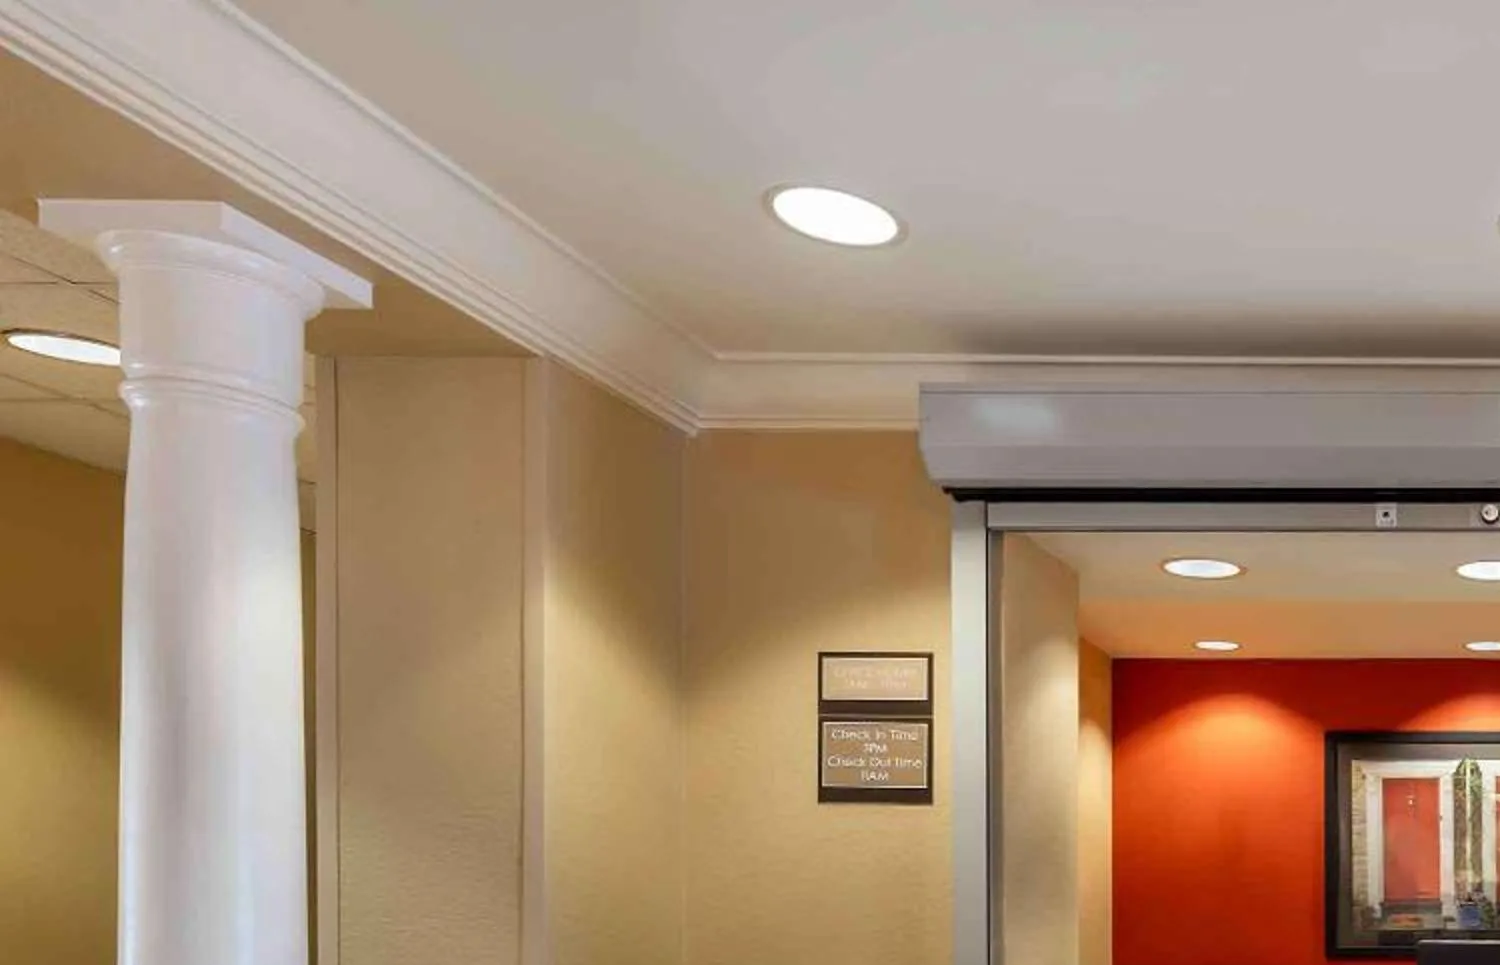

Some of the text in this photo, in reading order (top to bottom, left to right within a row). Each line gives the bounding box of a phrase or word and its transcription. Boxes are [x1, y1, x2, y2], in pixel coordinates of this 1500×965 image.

[831, 729, 871, 741] Check
[889, 729, 918, 742] Time
[827, 756, 866, 769] Check
[869, 756, 891, 769] Out
